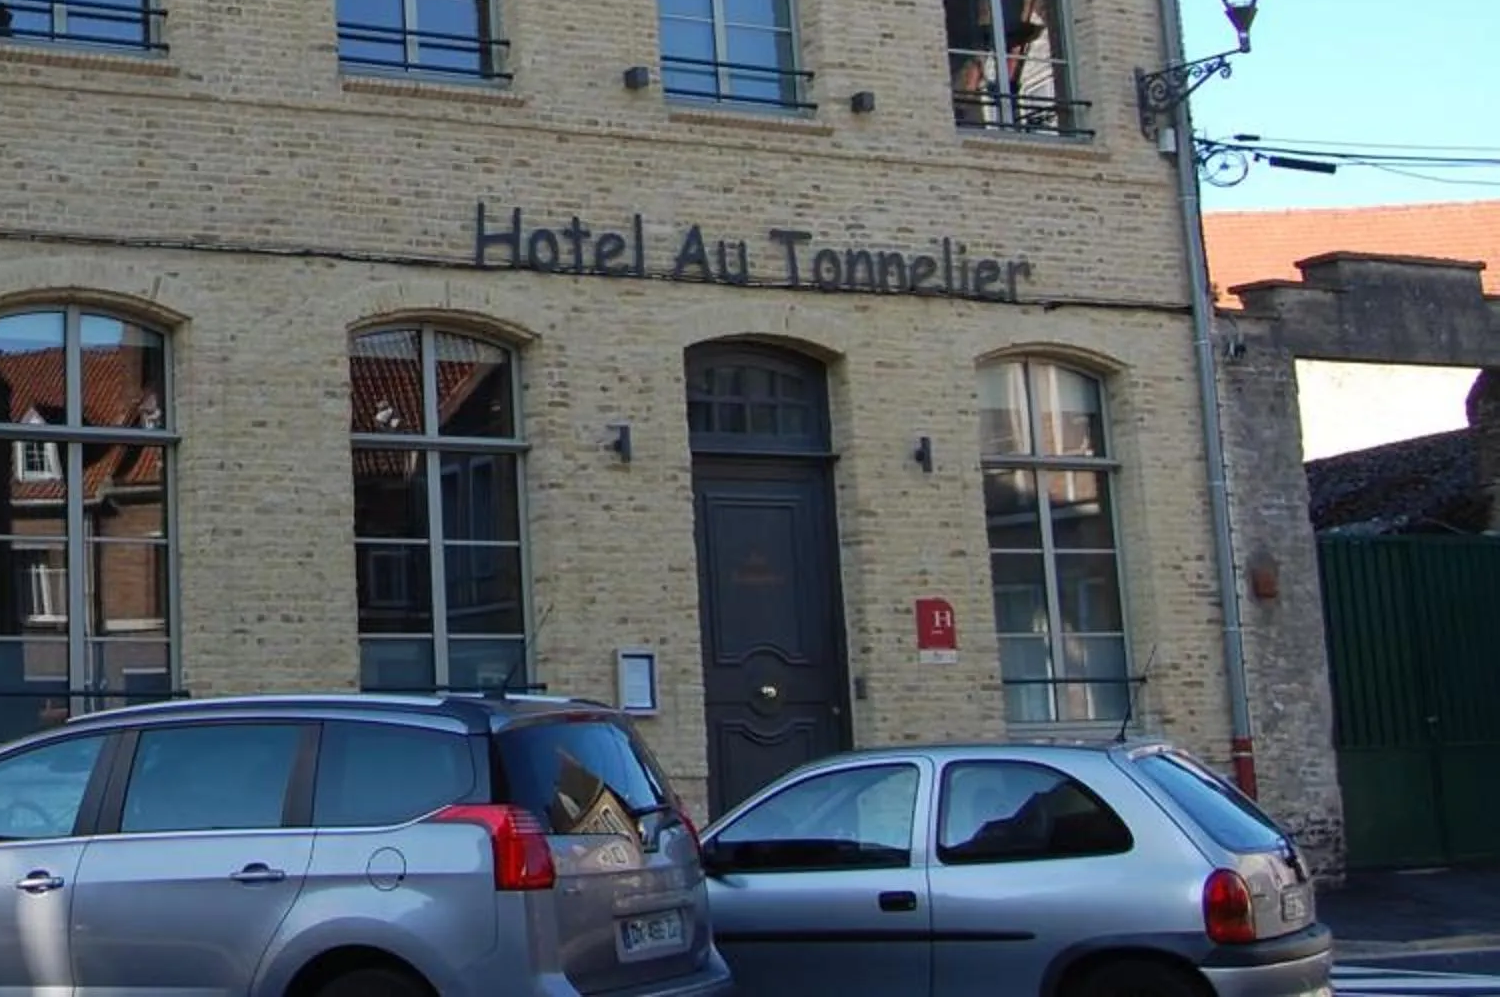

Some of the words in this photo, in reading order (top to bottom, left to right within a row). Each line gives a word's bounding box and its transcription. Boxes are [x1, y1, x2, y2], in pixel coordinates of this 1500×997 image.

[476, 203, 645, 277] Hotel
[674, 223, 749, 285] Au
[769, 228, 1031, 302] Tonnelier
